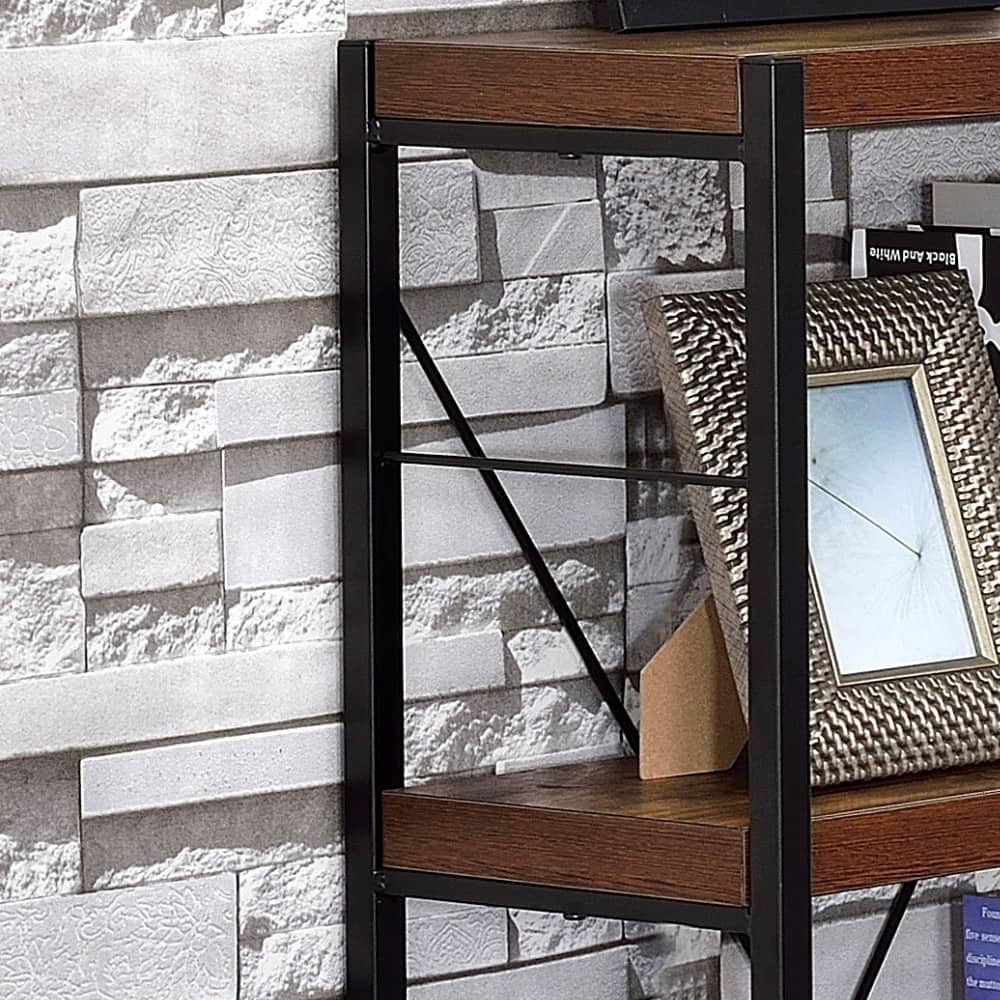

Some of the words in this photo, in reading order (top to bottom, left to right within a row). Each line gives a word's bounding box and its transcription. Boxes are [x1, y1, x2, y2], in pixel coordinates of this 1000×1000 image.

[869, 247, 901, 261] White
[902, 249, 924, 263] And
[926, 251, 956, 265] Black
[966, 975, 977, 987] the
